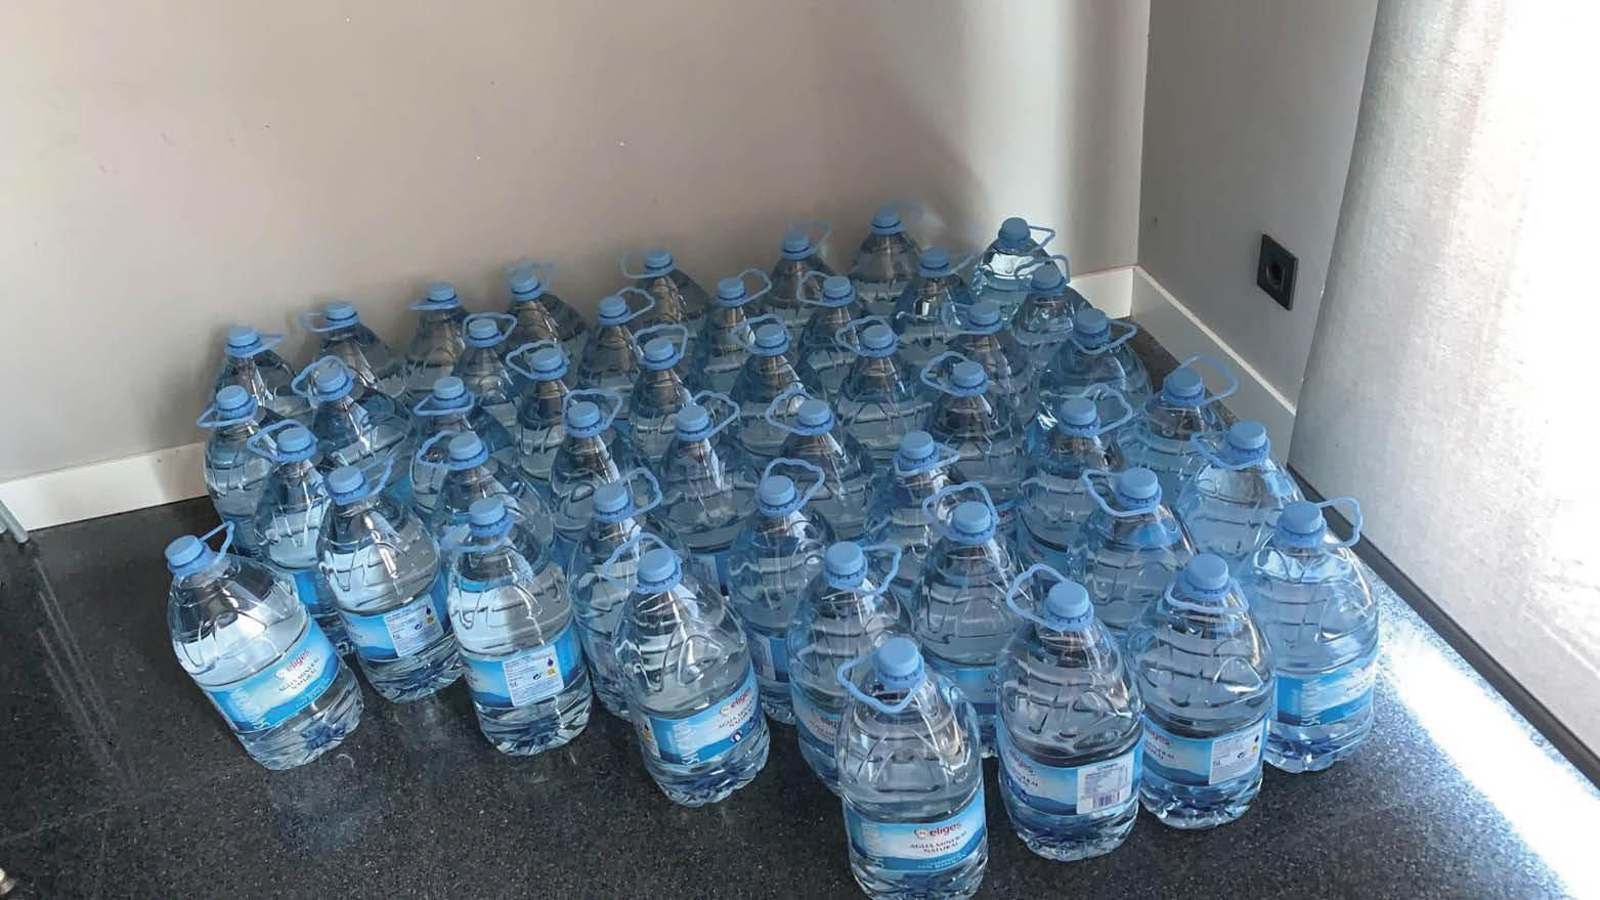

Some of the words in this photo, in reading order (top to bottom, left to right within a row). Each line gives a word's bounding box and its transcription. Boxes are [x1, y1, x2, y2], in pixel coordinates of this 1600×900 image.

[929, 821, 962, 838] eliges
[923, 841, 959, 853] NATURAL
[936, 830, 967, 848] MINERAL
